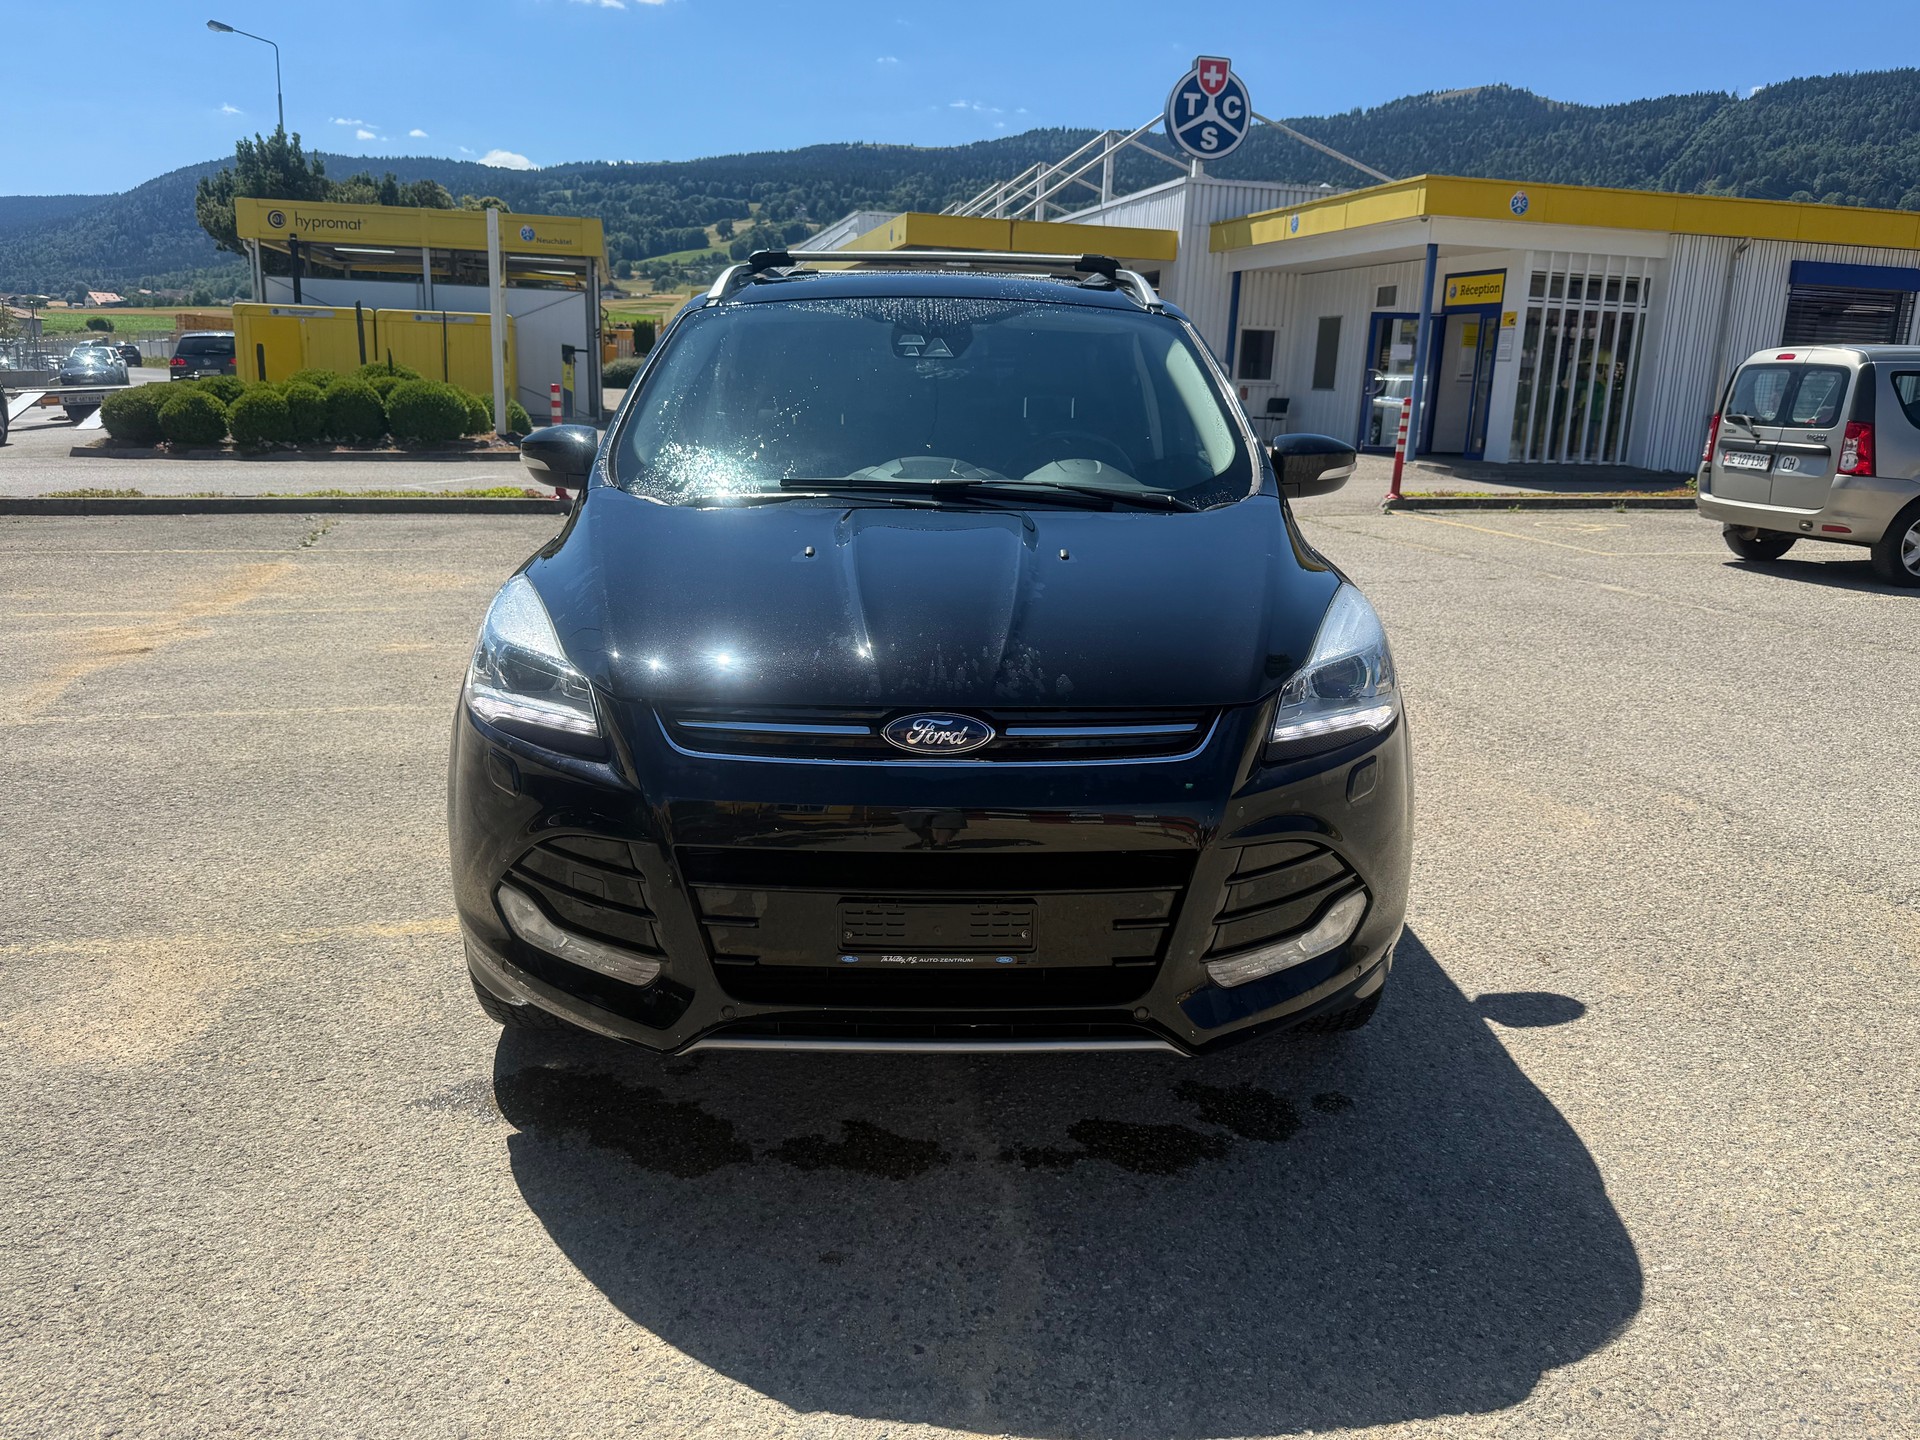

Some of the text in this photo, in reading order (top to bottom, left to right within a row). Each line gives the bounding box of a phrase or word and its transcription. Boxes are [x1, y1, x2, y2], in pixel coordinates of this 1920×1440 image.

[1183, 92, 1242, 151] TCS
[295, 210, 363, 232] hypromat
[1460, 283, 1500, 297] Réception
[1782, 457, 1796, 470] CH
[906, 718, 968, 745] Ford
